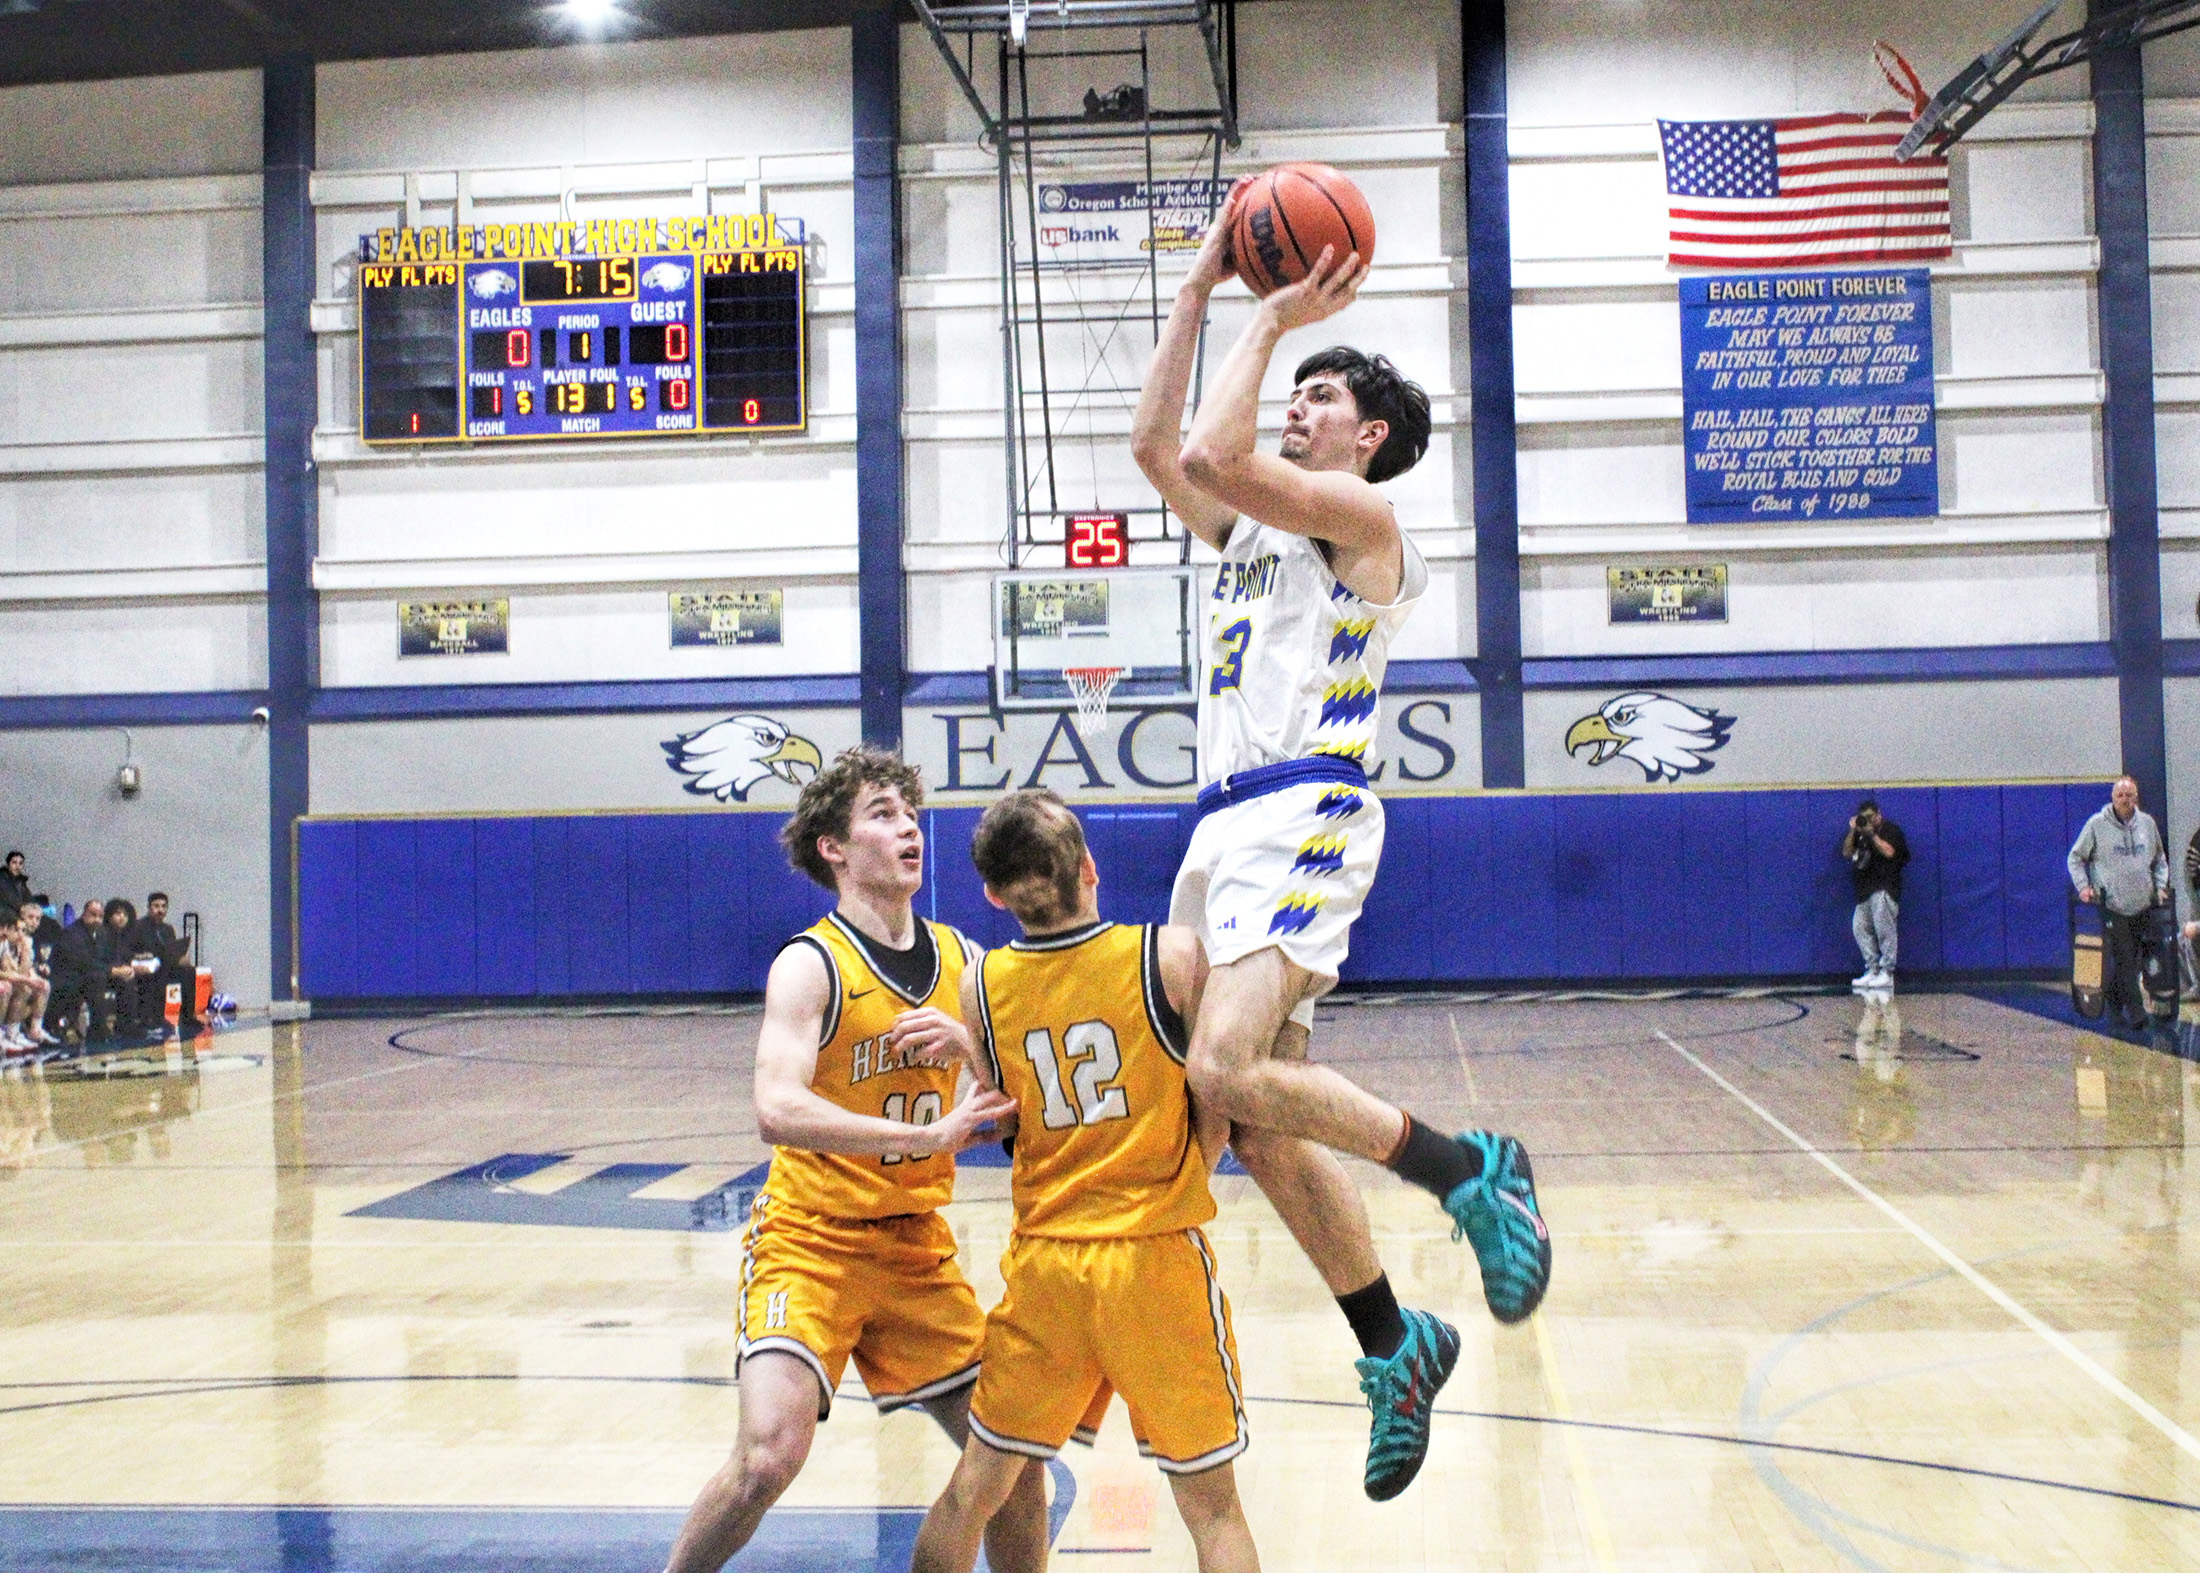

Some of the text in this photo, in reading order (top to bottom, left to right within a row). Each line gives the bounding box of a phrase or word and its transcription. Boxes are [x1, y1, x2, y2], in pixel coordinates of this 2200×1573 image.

[1136, 182, 1187, 195] Mmber
[1191, 181, 1204, 193] of
[1068, 196, 1115, 212] Oregon
[376, 212, 784, 262] EAGLE POINT HIGH SCHOOL
[1069, 225, 1119, 242] bank
[703, 251, 796, 275] PLY FL PTS
[364, 265, 456, 288] PLY FL PTS
[553, 257, 632, 296] 7:15
[1709, 275, 1907, 300] EAGLE POINT FOREVER
[470, 307, 532, 328] EAGLES
[558, 314, 600, 329] PERIOD
[630, 301, 686, 322] GUEST
[1705, 302, 1915, 328] EAGLE POINT FOREVER
[507, 328, 530, 367] 0
[582, 332, 589, 359] 1
[665, 322, 688, 361] 0
[1727, 324, 1896, 348] MAY WE ALWAYS BE
[1782, 348, 1837, 366] PROUD
[1837, 346, 1871, 364] AND
[1871, 344, 1920, 364] LOYAL
[469, 372, 505, 387] FOULS
[543, 368, 619, 384] PLAYER FOUL
[655, 365, 692, 380] FOULS
[1711, 365, 1908, 390] IN OUR LOVE FOR THEE
[492, 387, 500, 414] 1
[557, 382, 585, 413] 13
[606, 383, 615, 410] 1
[669, 379, 688, 410] 0
[656, 414, 693, 430] SCORE
[744, 399, 759, 424] 0
[1691, 409, 1734, 430] HAIL,
[1736, 408, 1778, 429] HAIL,
[1780, 407, 1813, 427] THE
[1865, 405, 1892, 425] ALL
[1892, 403, 1930, 424] HERE
[469, 421, 506, 436] SCORE
[561, 418, 600, 433] MATCH
[1706, 426, 1919, 450] ROUND OUR COLORS BOLD
[1745, 449, 1796, 470] STICK
[1798, 447, 1876, 467] TOGETHER
[1877, 446, 1905, 466] FOR
[1905, 445, 1933, 465] THE
[1722, 467, 1902, 491] ROYAL BLUE AND GOLD
[1752, 494, 1793, 513] Class
[1800, 492, 1821, 517] of
[1071, 520, 1121, 565] 25
[1231, 554, 1282, 604] POINT
[1022, 1018, 1130, 1131] 12
[764, 1291, 789, 1329] H
